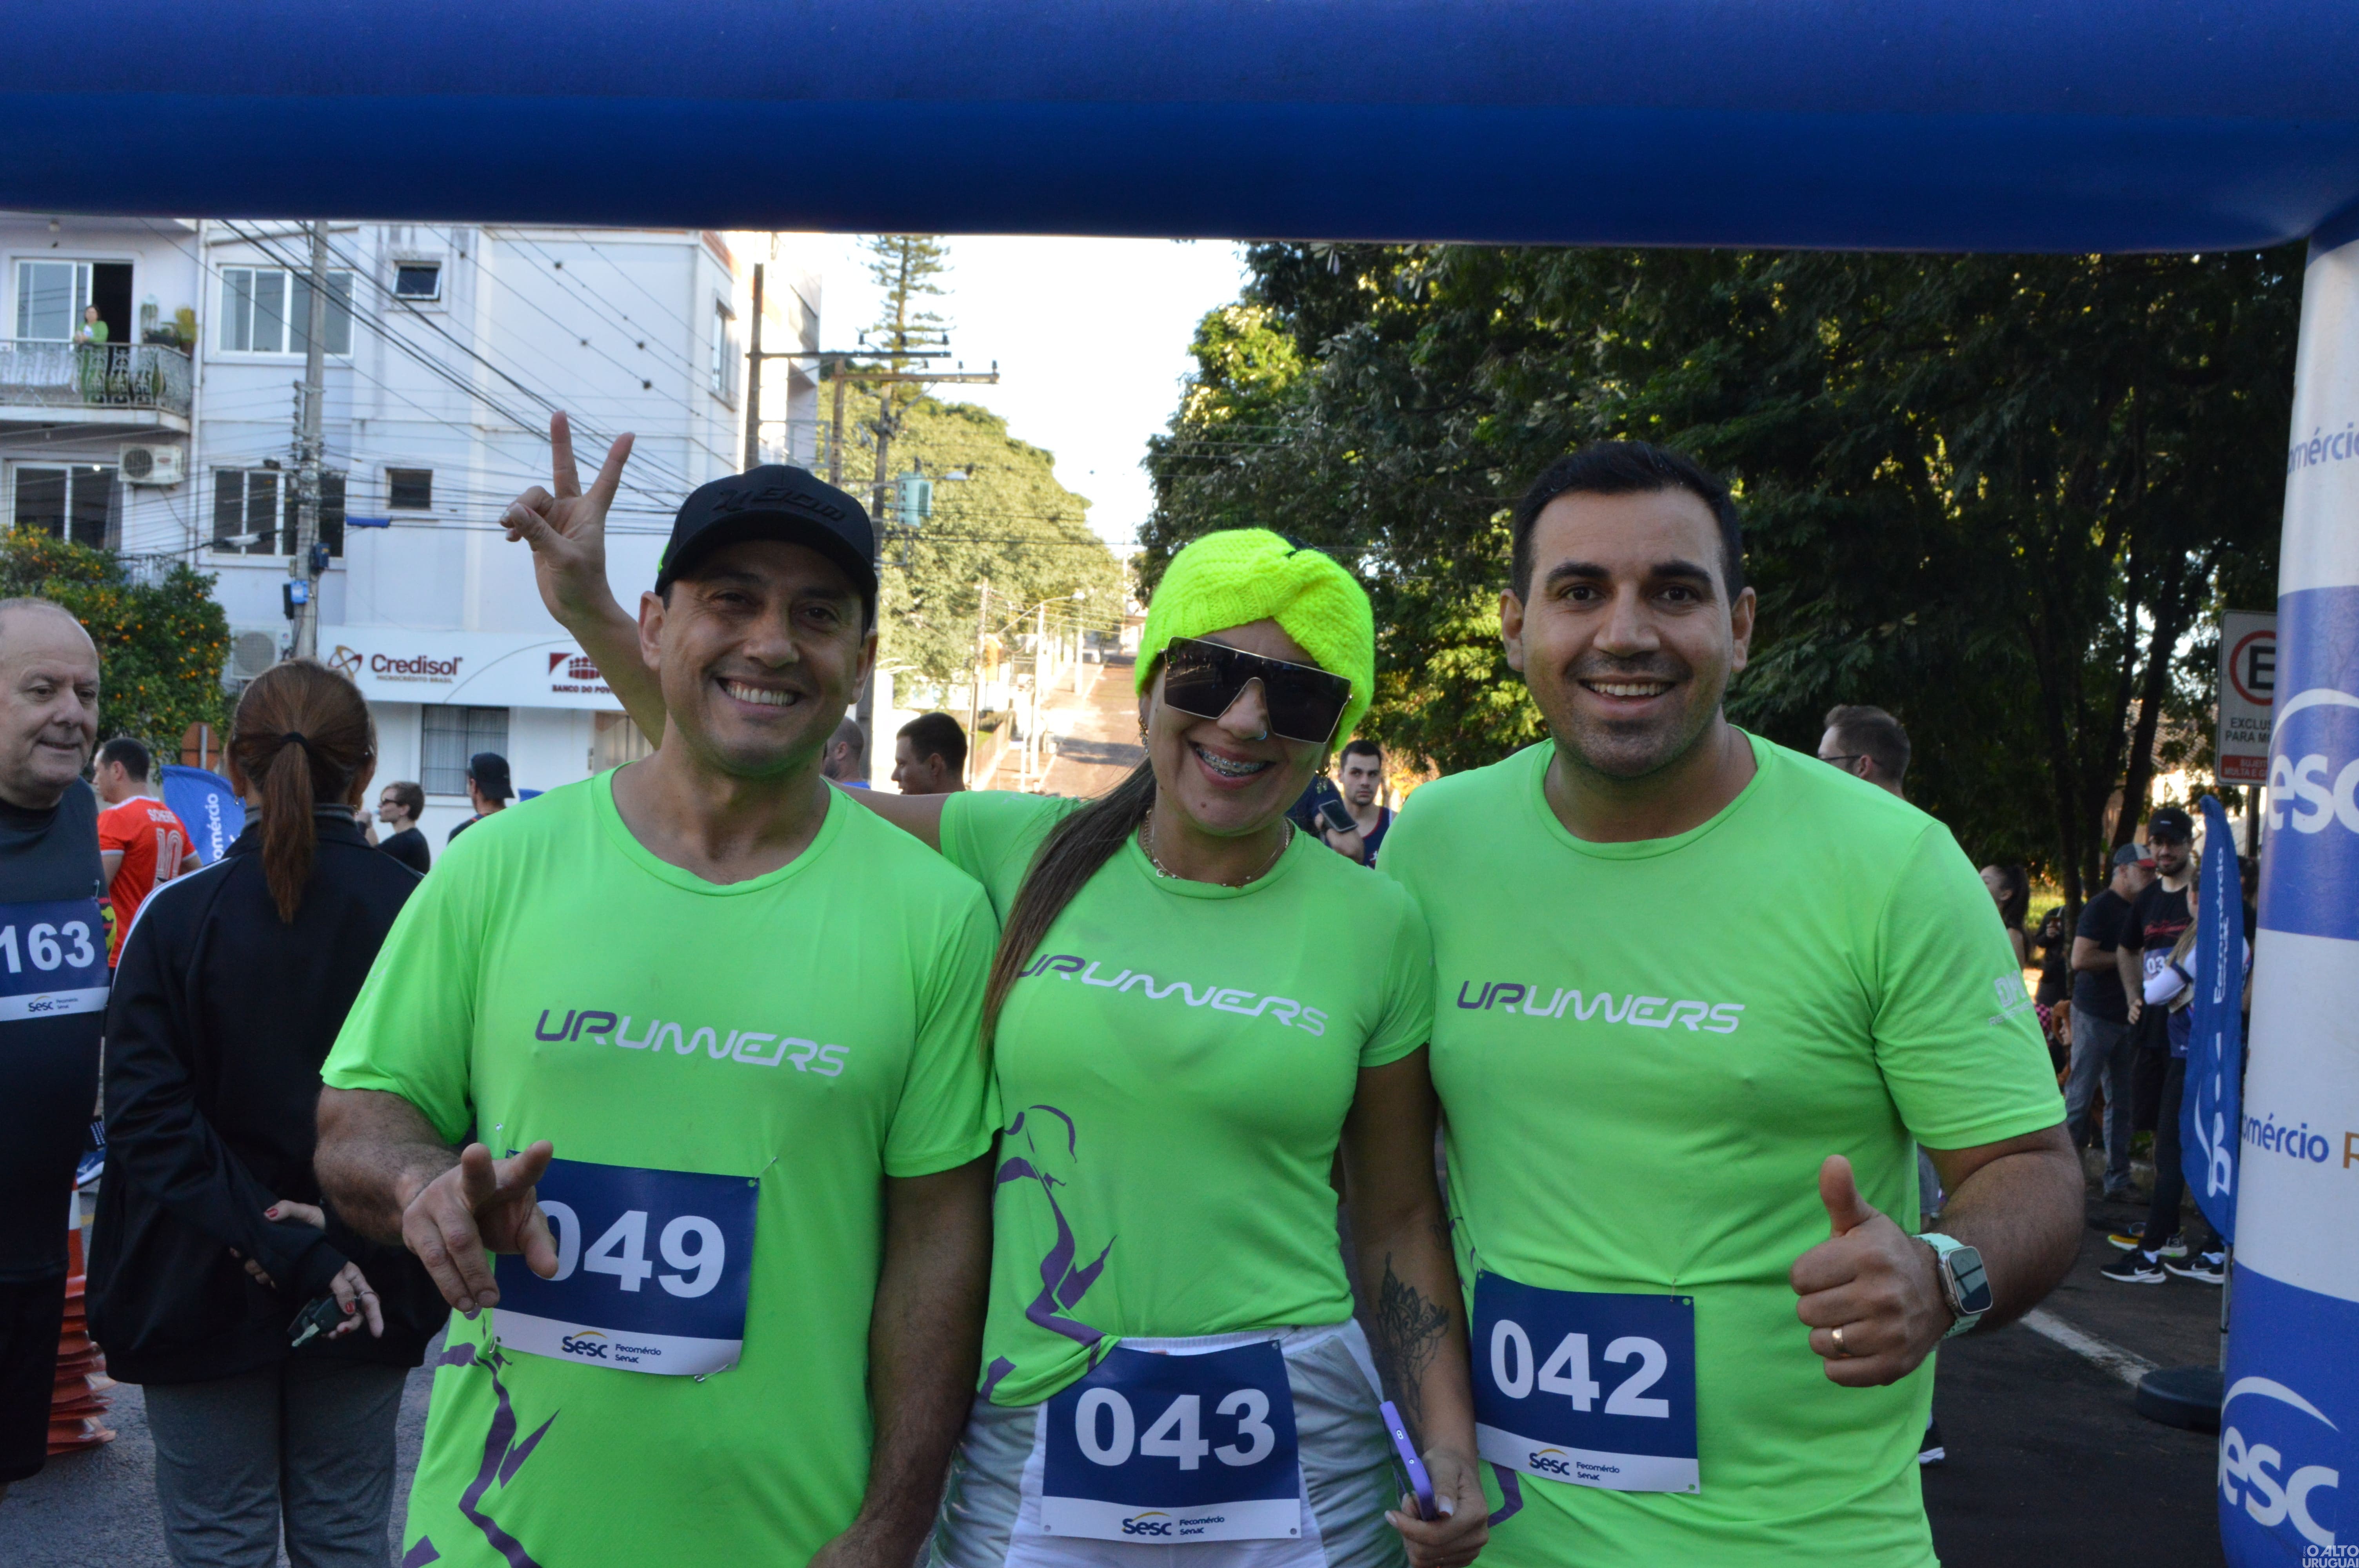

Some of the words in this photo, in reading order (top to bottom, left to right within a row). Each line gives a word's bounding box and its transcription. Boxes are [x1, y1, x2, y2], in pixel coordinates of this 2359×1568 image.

[2225, 731, 2255, 742] PARA
[0, 921, 95, 973] 163
[531, 1200, 725, 1298] 049
[615, 1344, 662, 1356] Fecomércio
[615, 1354, 639, 1363] Senac
[1491, 1319, 1669, 1418] 042
[1075, 1387, 1275, 1470] 043
[1576, 1462, 1620, 1474] Fecomércio
[1577, 1472, 1600, 1481] Senac
[1180, 1516, 1225, 1526] Fecomércio
[1180, 1527, 1204, 1535] Senac
